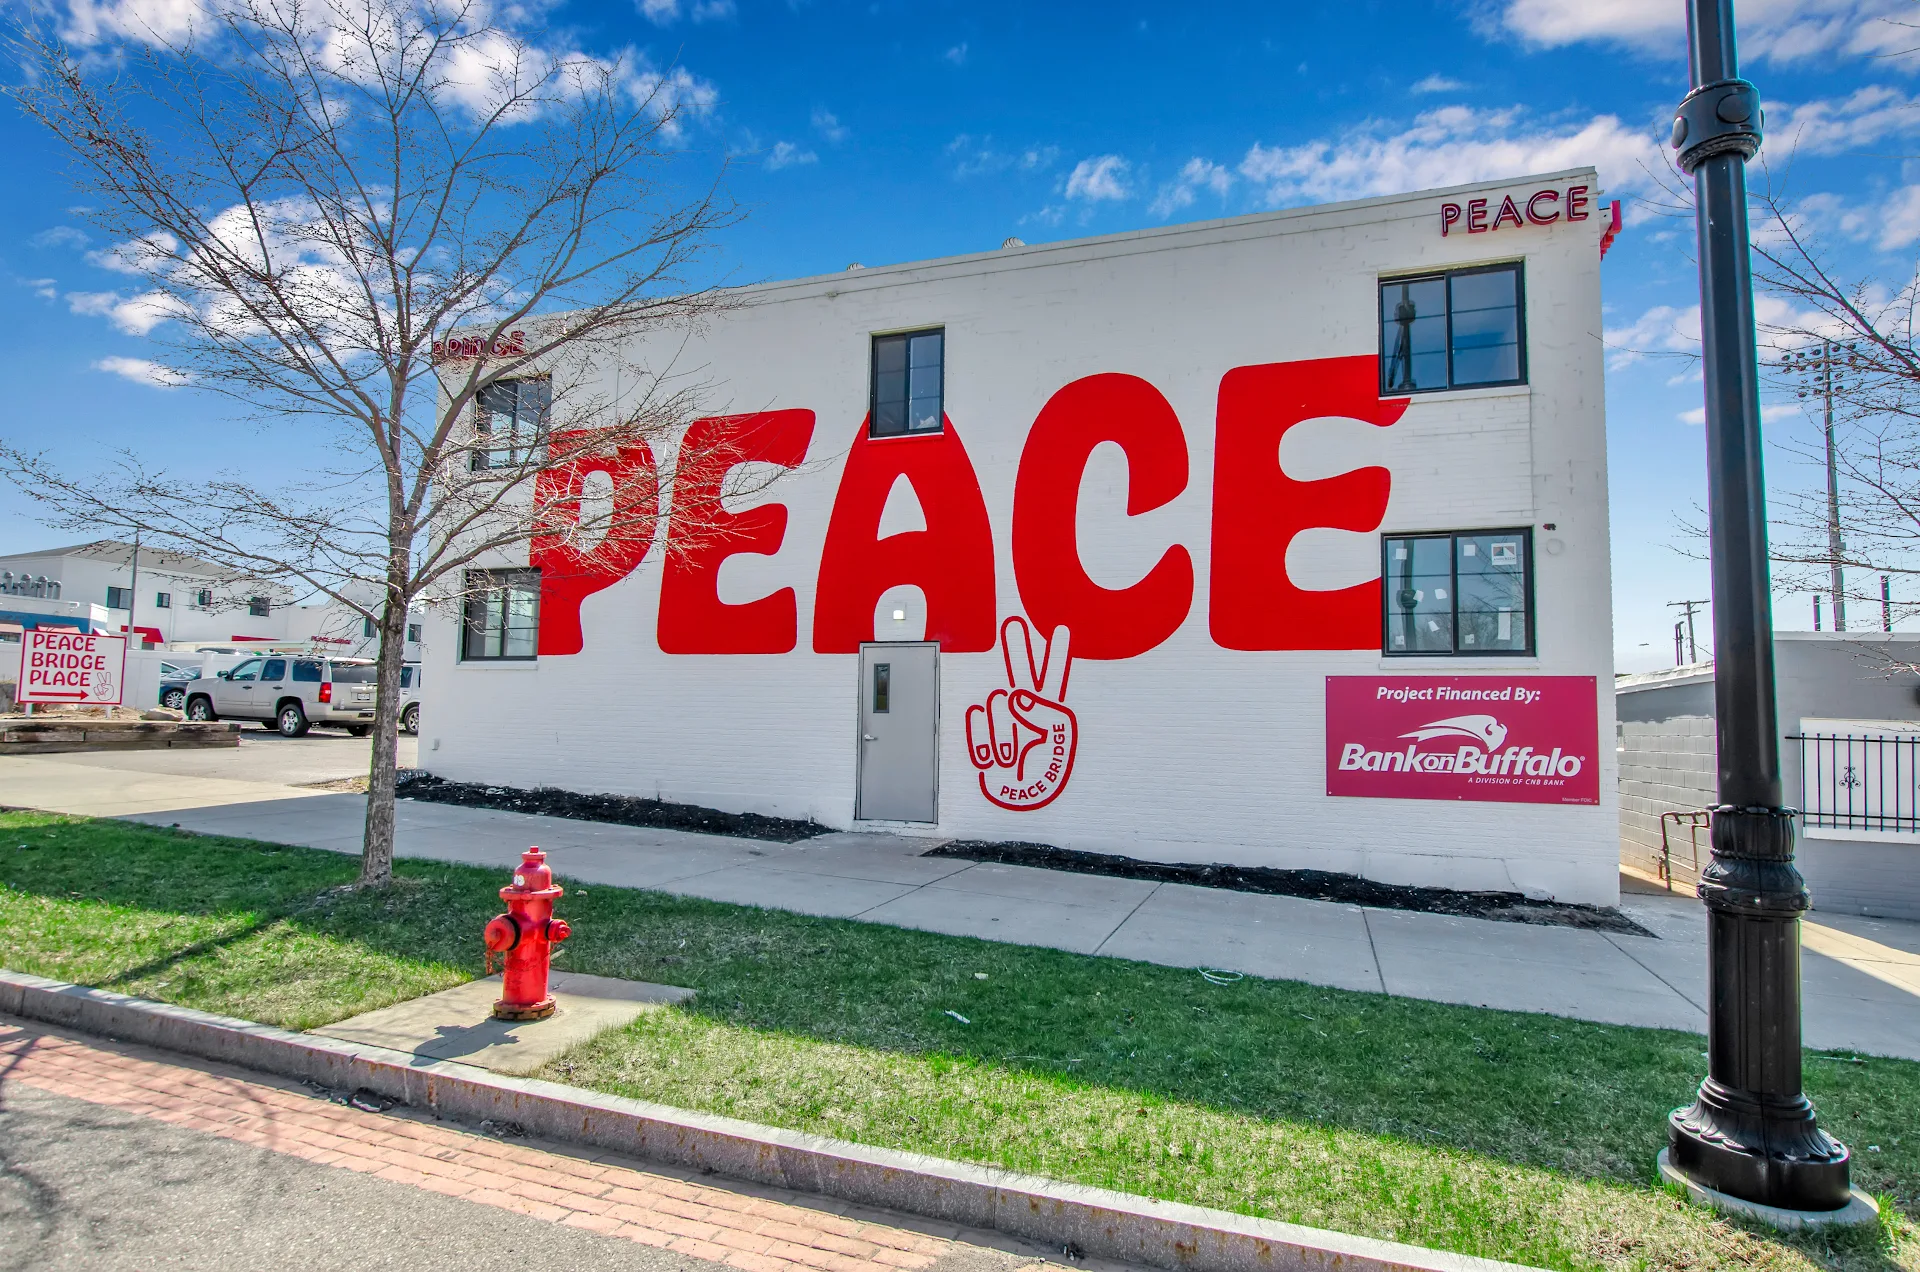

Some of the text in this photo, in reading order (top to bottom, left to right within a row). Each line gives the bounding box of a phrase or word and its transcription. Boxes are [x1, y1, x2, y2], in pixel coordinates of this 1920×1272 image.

[1441, 185, 1589, 237] PEACE
[530, 354, 1412, 661] PEACE
[33, 633, 97, 651] PEACE
[31, 652, 106, 671] BRIDGE
[29, 671, 92, 687] PLACE
[1376, 686, 1541, 705] Project Financed By:
[1000, 723, 1065, 800] PEACE BRIDGE
[1475, 777, 1510, 785] DIVISION
[1525, 778, 1541, 786] CNB
